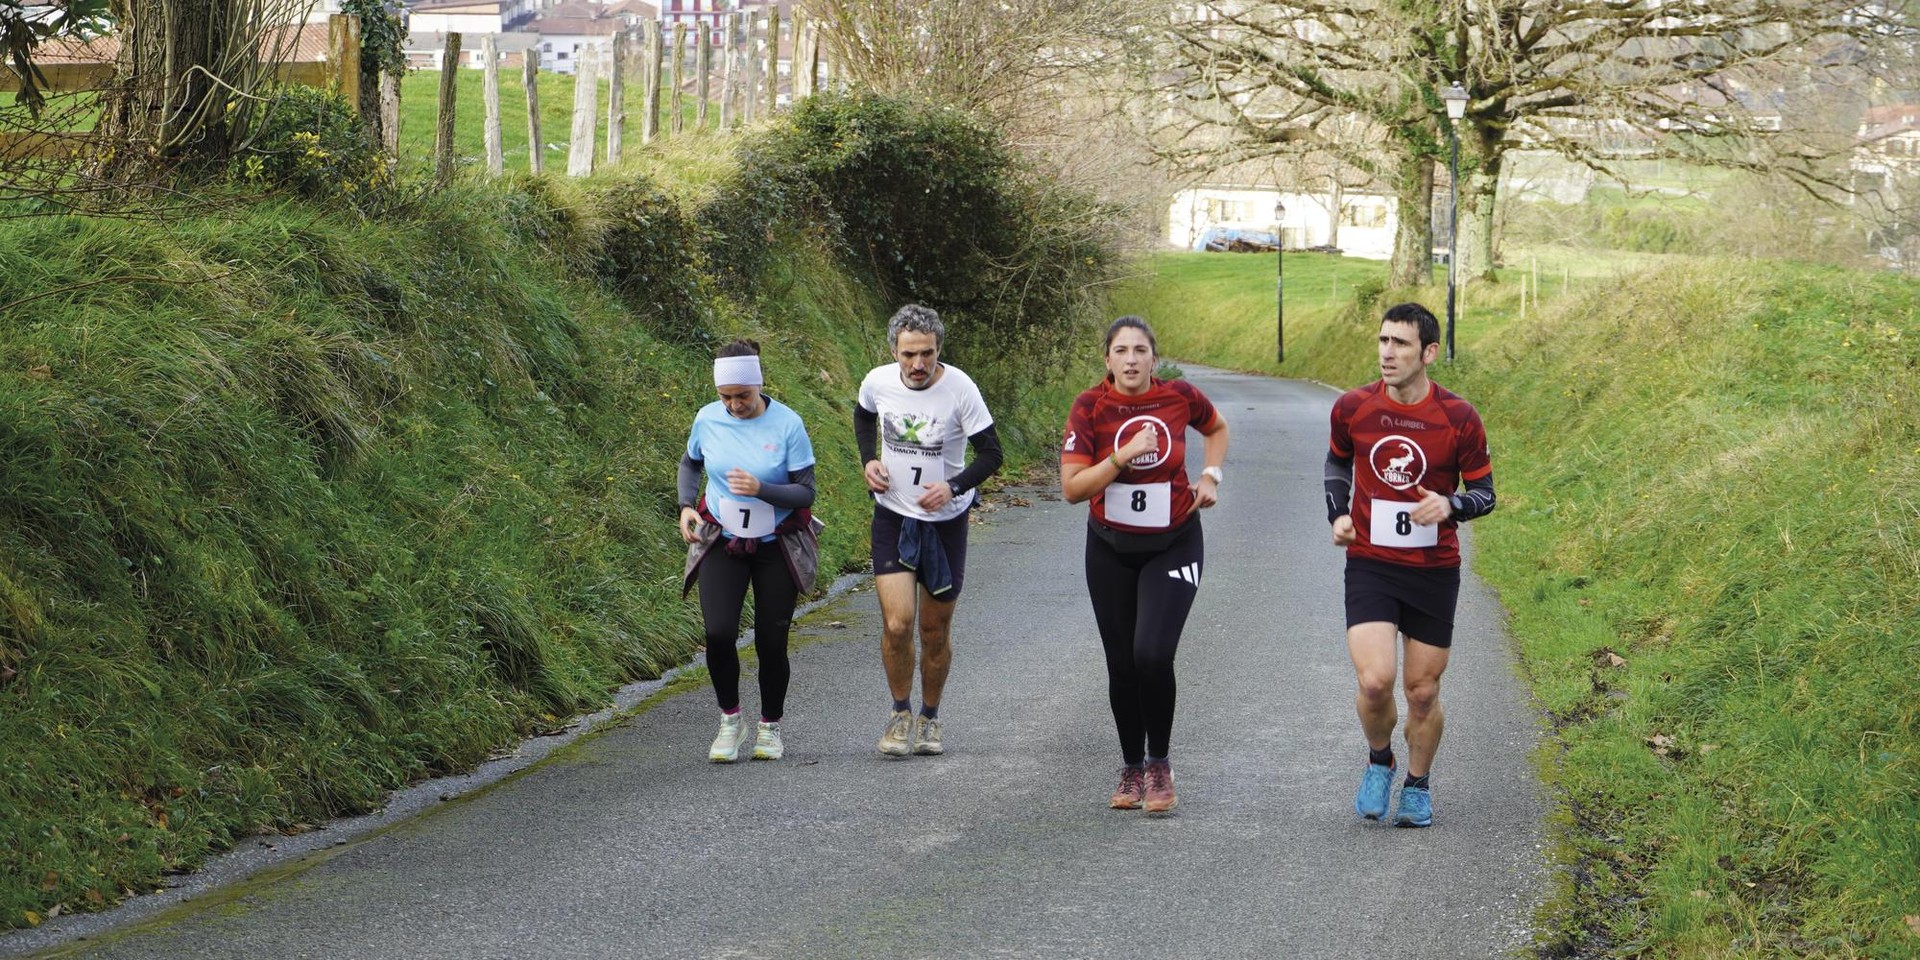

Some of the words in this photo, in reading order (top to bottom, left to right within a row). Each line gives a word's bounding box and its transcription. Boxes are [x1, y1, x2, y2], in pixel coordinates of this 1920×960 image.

[1394, 417, 1426, 430] LURBEL
[911, 467, 922, 485] 7
[1131, 490, 1147, 512] 8
[739, 509, 751, 529] 7
[1395, 511, 1412, 536] 8
